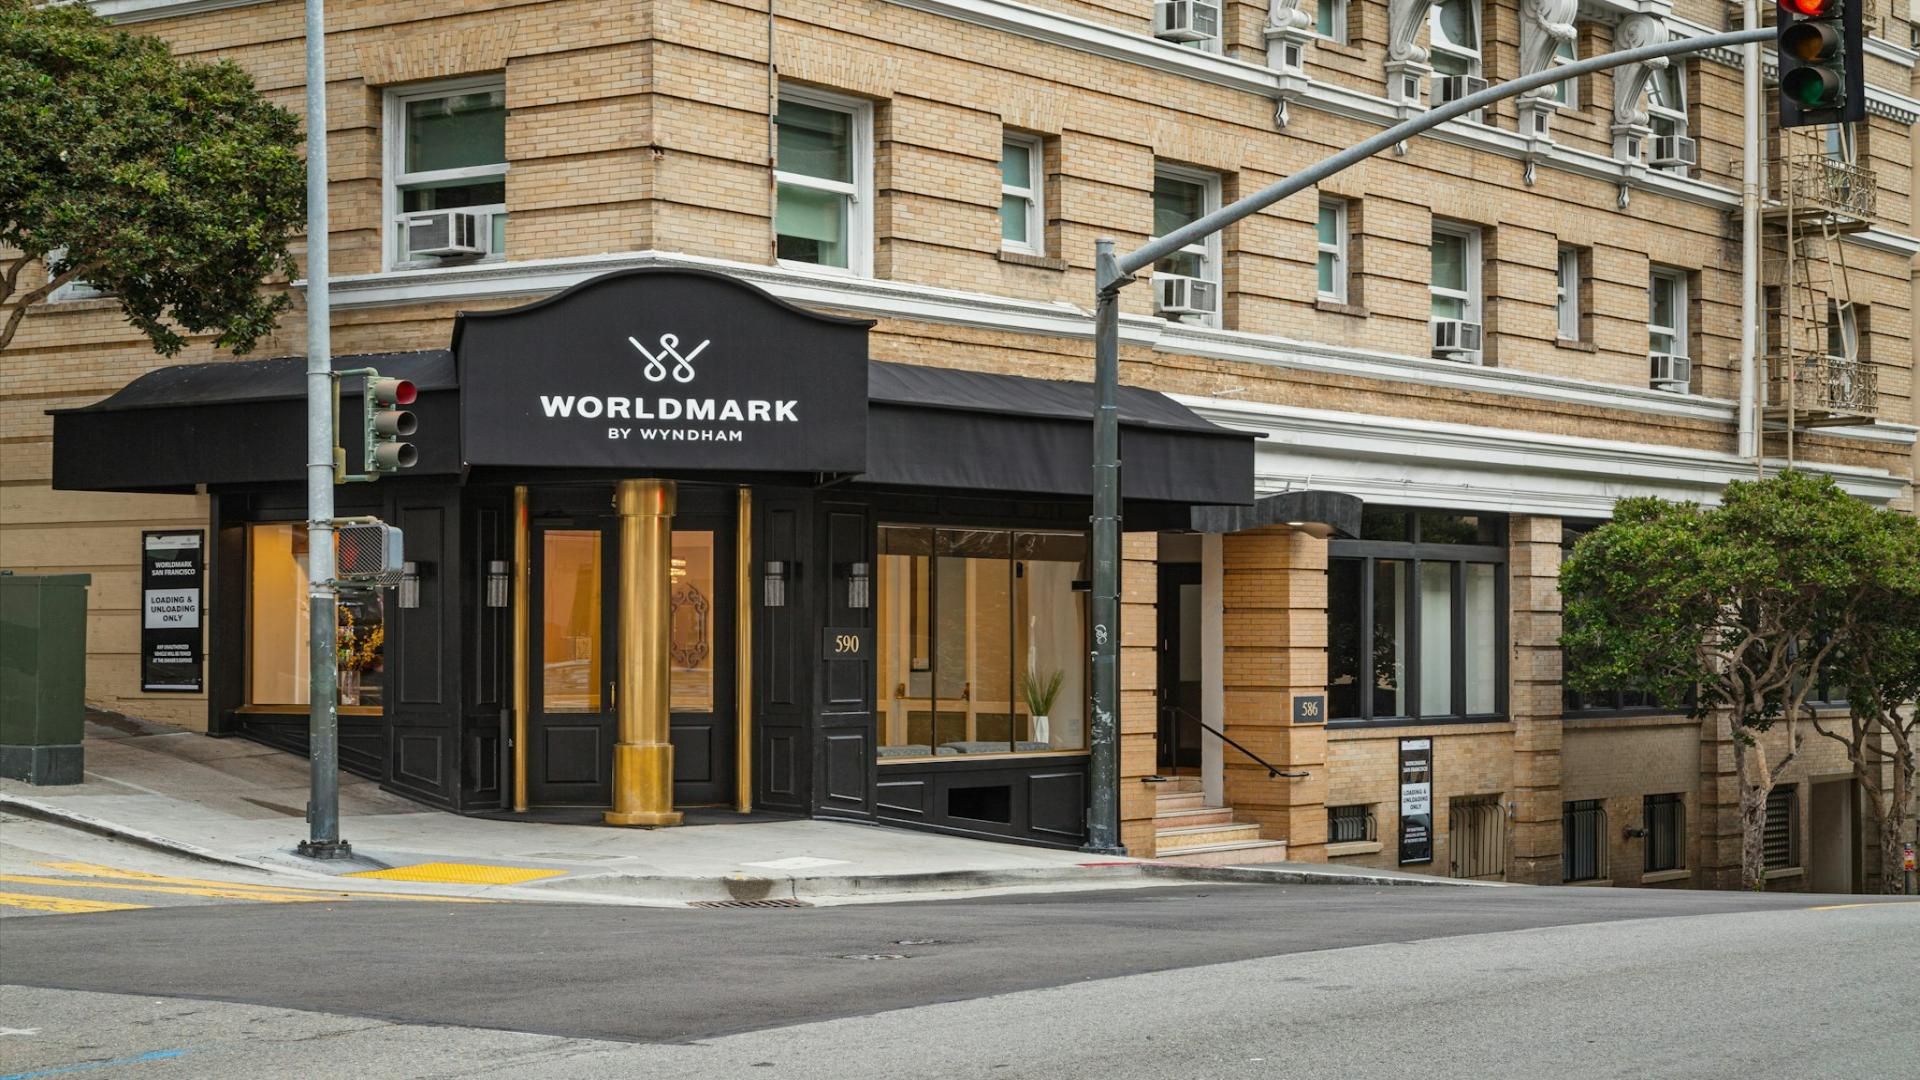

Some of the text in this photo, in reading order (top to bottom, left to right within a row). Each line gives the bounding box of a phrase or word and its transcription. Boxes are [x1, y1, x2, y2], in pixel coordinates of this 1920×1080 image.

[540, 395, 799, 422] WORLDMARK
[608, 428, 743, 442] BY WYNDHAM
[164, 568, 196, 576] FRANCISCO
[151, 596, 185, 604] LOADING
[151, 605, 195, 613] UNLOADING
[162, 614, 183, 622] ONLY
[835, 635, 859, 653] 590
[1301, 701, 1318, 717] 586
